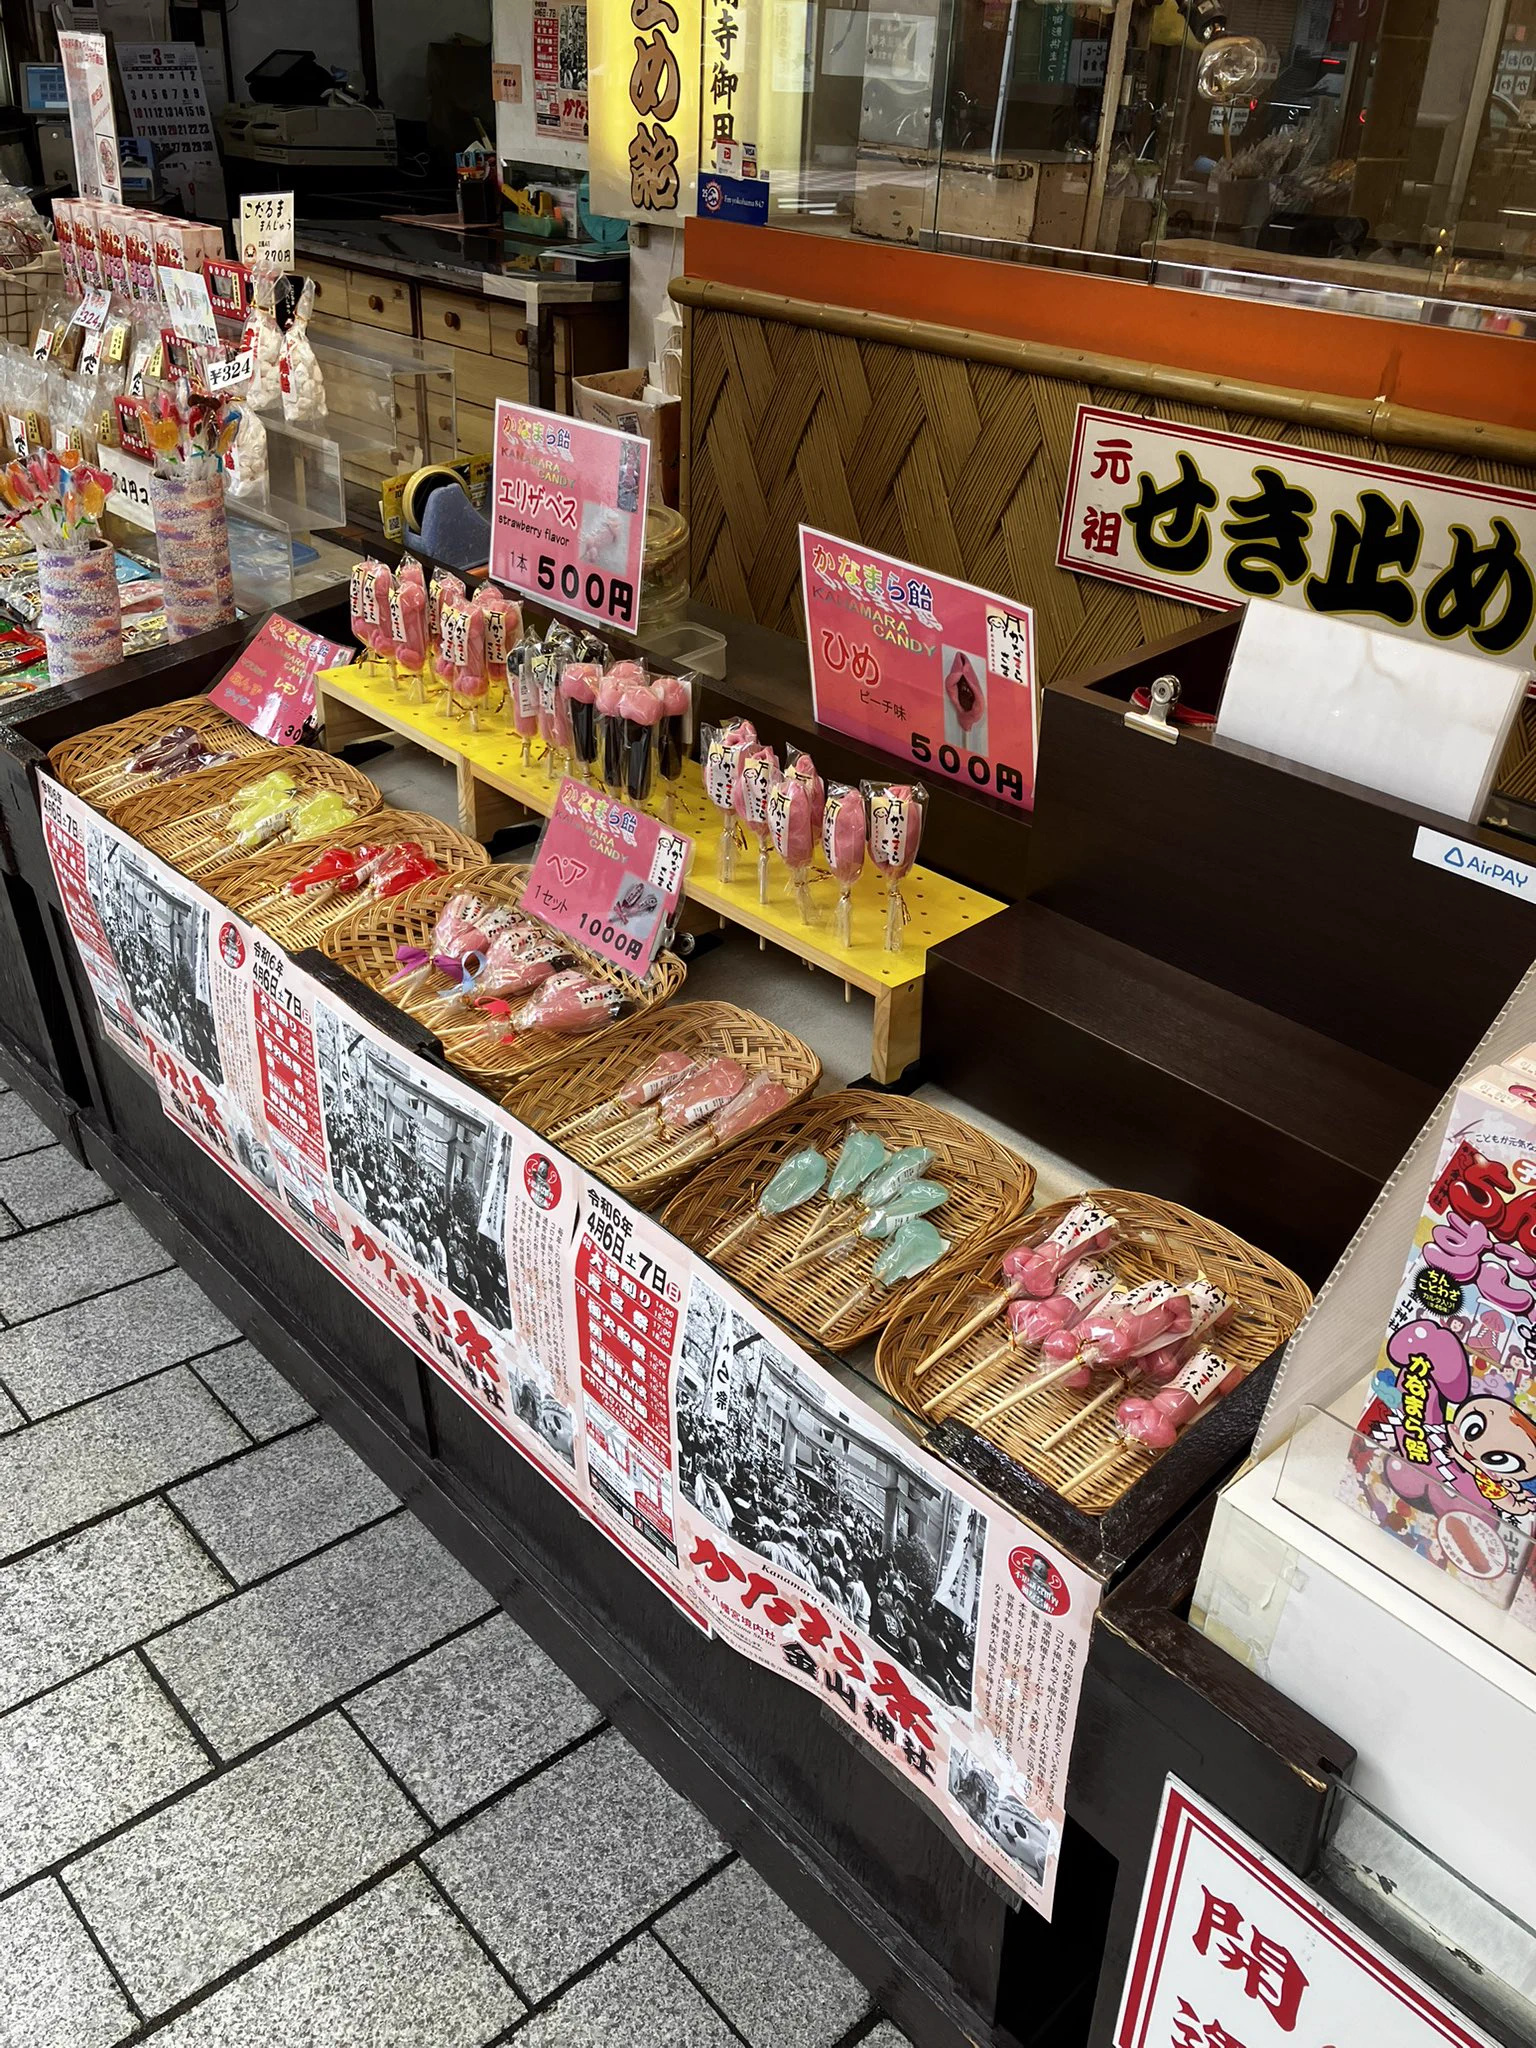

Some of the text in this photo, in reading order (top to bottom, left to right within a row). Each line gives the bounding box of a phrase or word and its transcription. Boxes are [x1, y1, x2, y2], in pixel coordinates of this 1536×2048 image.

[152, 48, 162, 65] 3
[190, 71, 197, 81] 2
[130, 88, 200, 100] 3 4 5 6 7 8 9
[144, 107, 153, 118] 11
[154, 107, 164, 118] 12
[164, 107, 174, 117] 13
[174, 107, 184, 117] 14
[184, 106, 195, 117] 15
[195, 106, 205, 116] 16
[136, 126, 146, 136] 17
[178, 125, 188, 135] 21
[188, 124, 198, 134] 22
[199, 124, 210, 134] 23
[245, 200, 284, 219] こだるま
[259, 218, 292, 232] まんじゅう
[264, 249, 291, 263] 270円
[209, 356, 251, 387] ¥324
[503, 414, 571, 451] かなまら飴
[499, 479, 578, 530] エリザベス
[1090, 438, 1134, 557] 元祖
[498, 514, 571, 548] strawberry flavor
[510, 550, 634, 623] 1本 500円
[811, 543, 935, 614] かなまら飴
[821, 627, 882, 688] ひめ
[872, 623, 937, 659] CANDY
[859, 688, 908, 722] ピーチ味
[911, 731, 1024, 802] 500円
[561, 783, 638, 835] かなまら飴
[547, 853, 589, 888] ペア
[1466, 856, 1529, 888] AirPAY
[534, 884, 569, 915] 1セット
[578, 912, 644, 961] 1000円
[253, 941, 285, 978] 令和6年
[586, 1188, 634, 1238] 令和6年
[1418, 1278, 1463, 1303] ことわざ
[1427, 1269, 1451, 1288] ちん
[761, 1563, 816, 1609] Kanamara
[689, 1534, 939, 1753] かなまら祭
[782, 1640, 937, 1788] 金山神社
